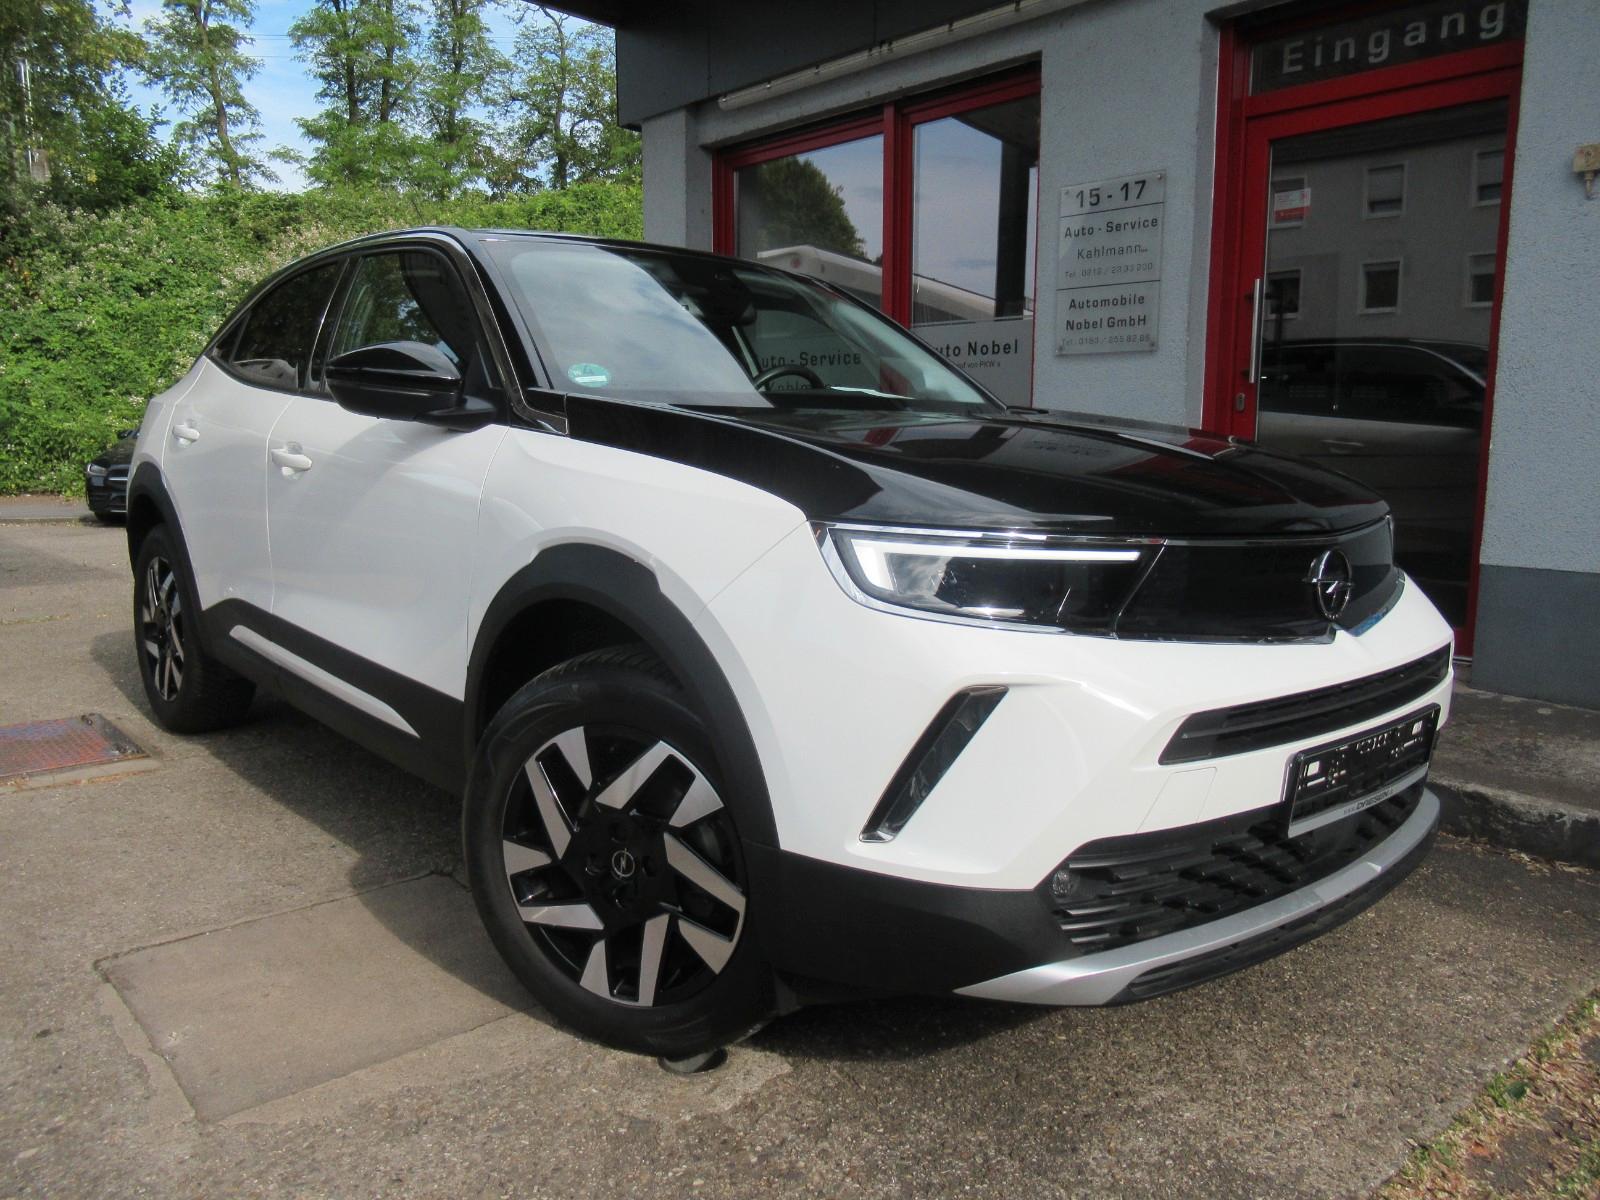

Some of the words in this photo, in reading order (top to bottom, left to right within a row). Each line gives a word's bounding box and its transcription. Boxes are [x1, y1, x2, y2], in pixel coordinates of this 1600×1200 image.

[1281, 3, 1506, 75] Eingang
[1075, 187, 1101, 209] 15
[1120, 179, 1147, 202] 17
[1064, 226, 1095, 239] Auto
[1106, 216, 1159, 234] Service
[1077, 243, 1142, 260] Kahlmann
[1068, 293, 1145, 311] Automobile
[1066, 316, 1103, 331] Nobel
[1107, 314, 1147, 329] GmbH
[936, 343, 961, 358] uto
[967, 338, 1018, 356] Nobel
[761, 355, 786, 368] uto
[799, 350, 862, 367] Service
